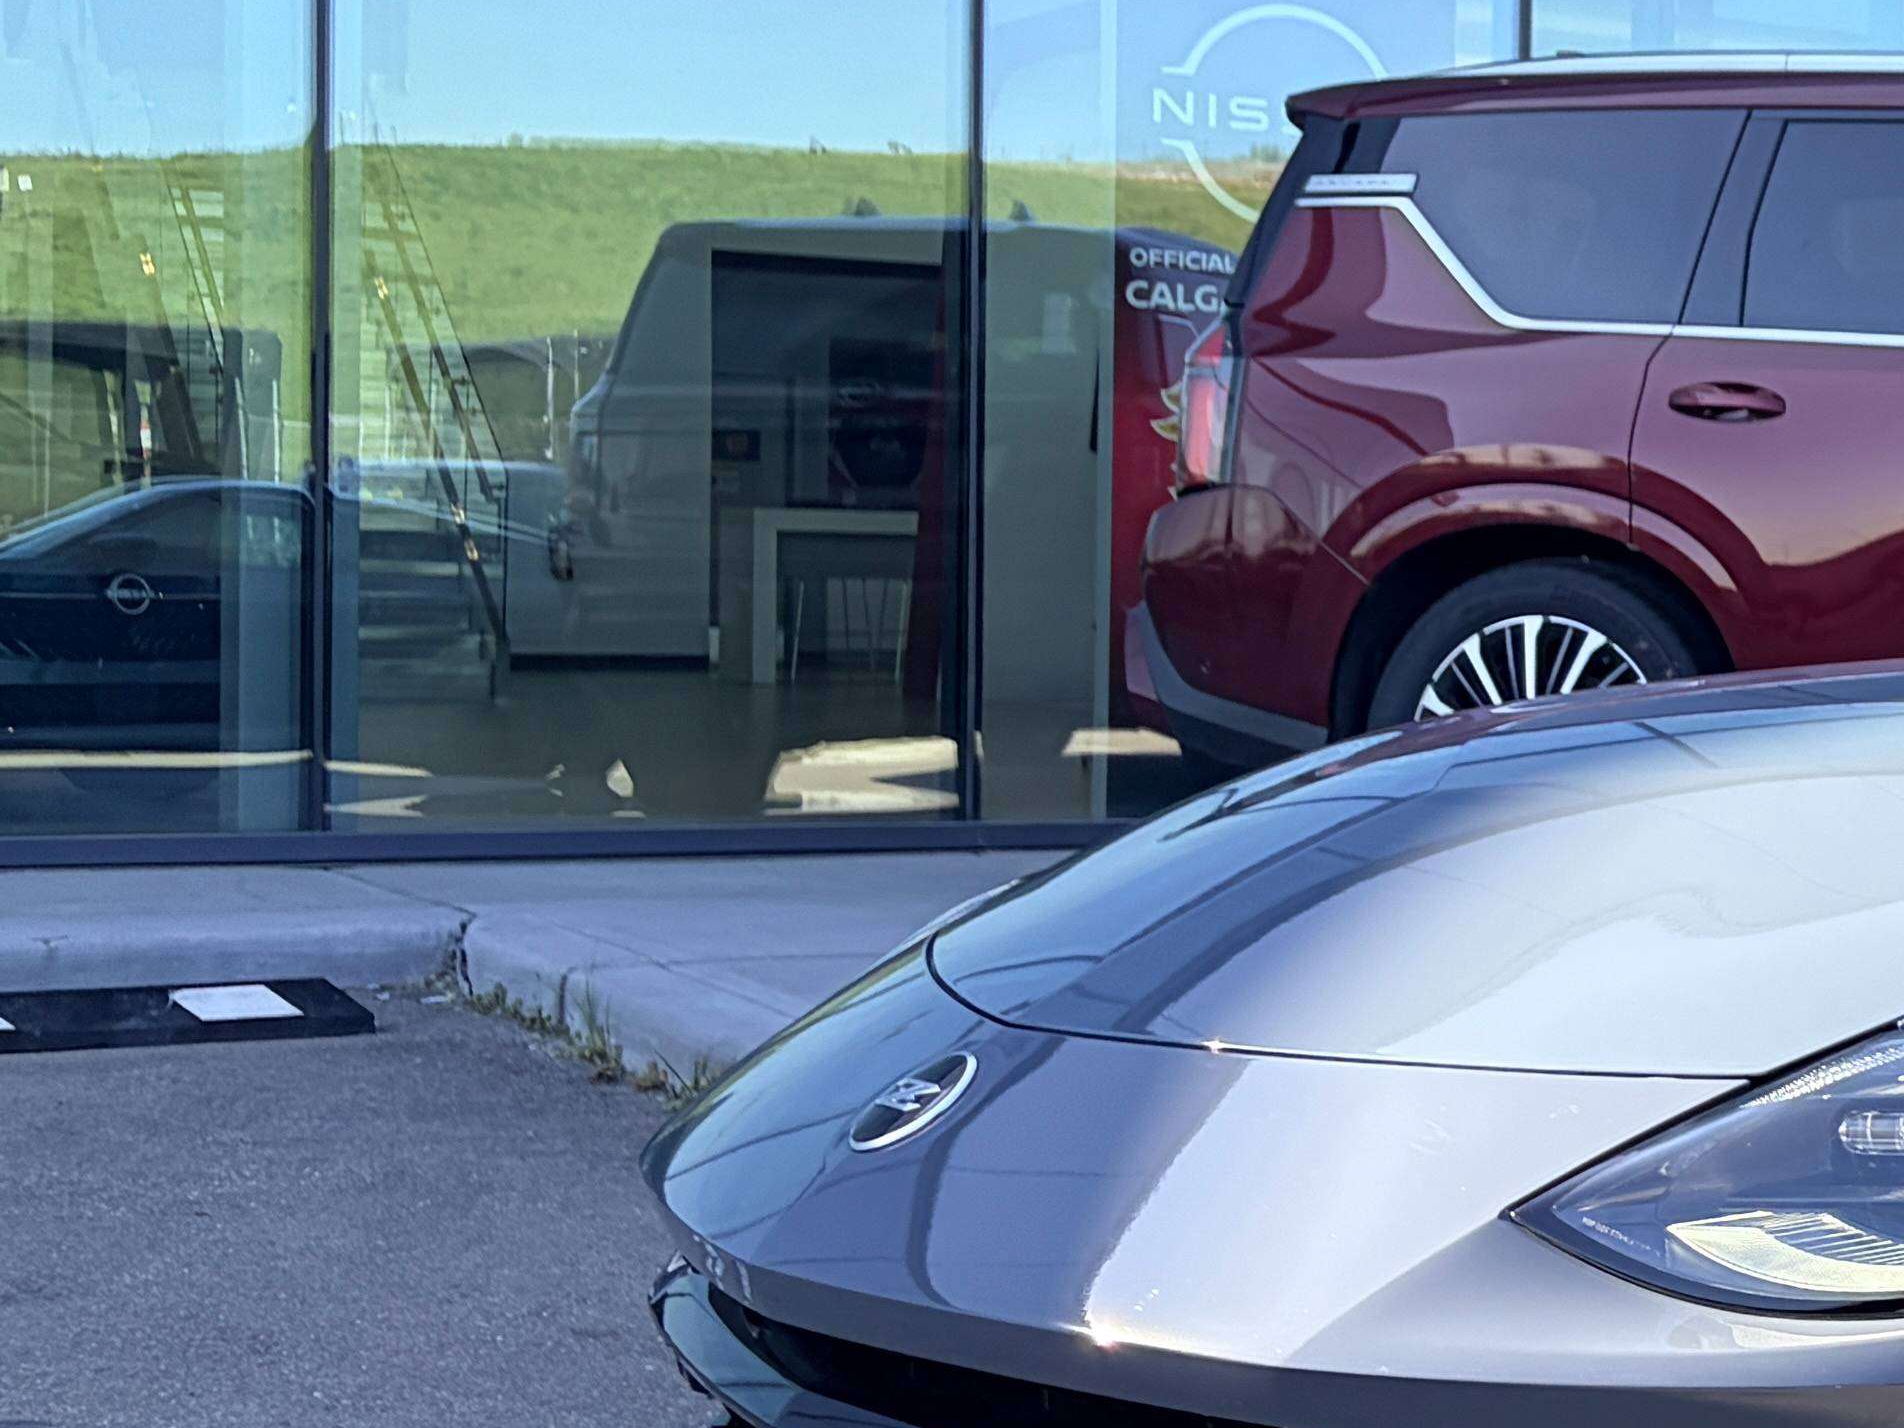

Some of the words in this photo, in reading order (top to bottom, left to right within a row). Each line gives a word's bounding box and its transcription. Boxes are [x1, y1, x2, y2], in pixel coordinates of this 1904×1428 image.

[1153, 87, 1304, 138] NIS
[1129, 247, 1236, 274] OFFICIAL
[1125, 279, 1228, 315] CALG
